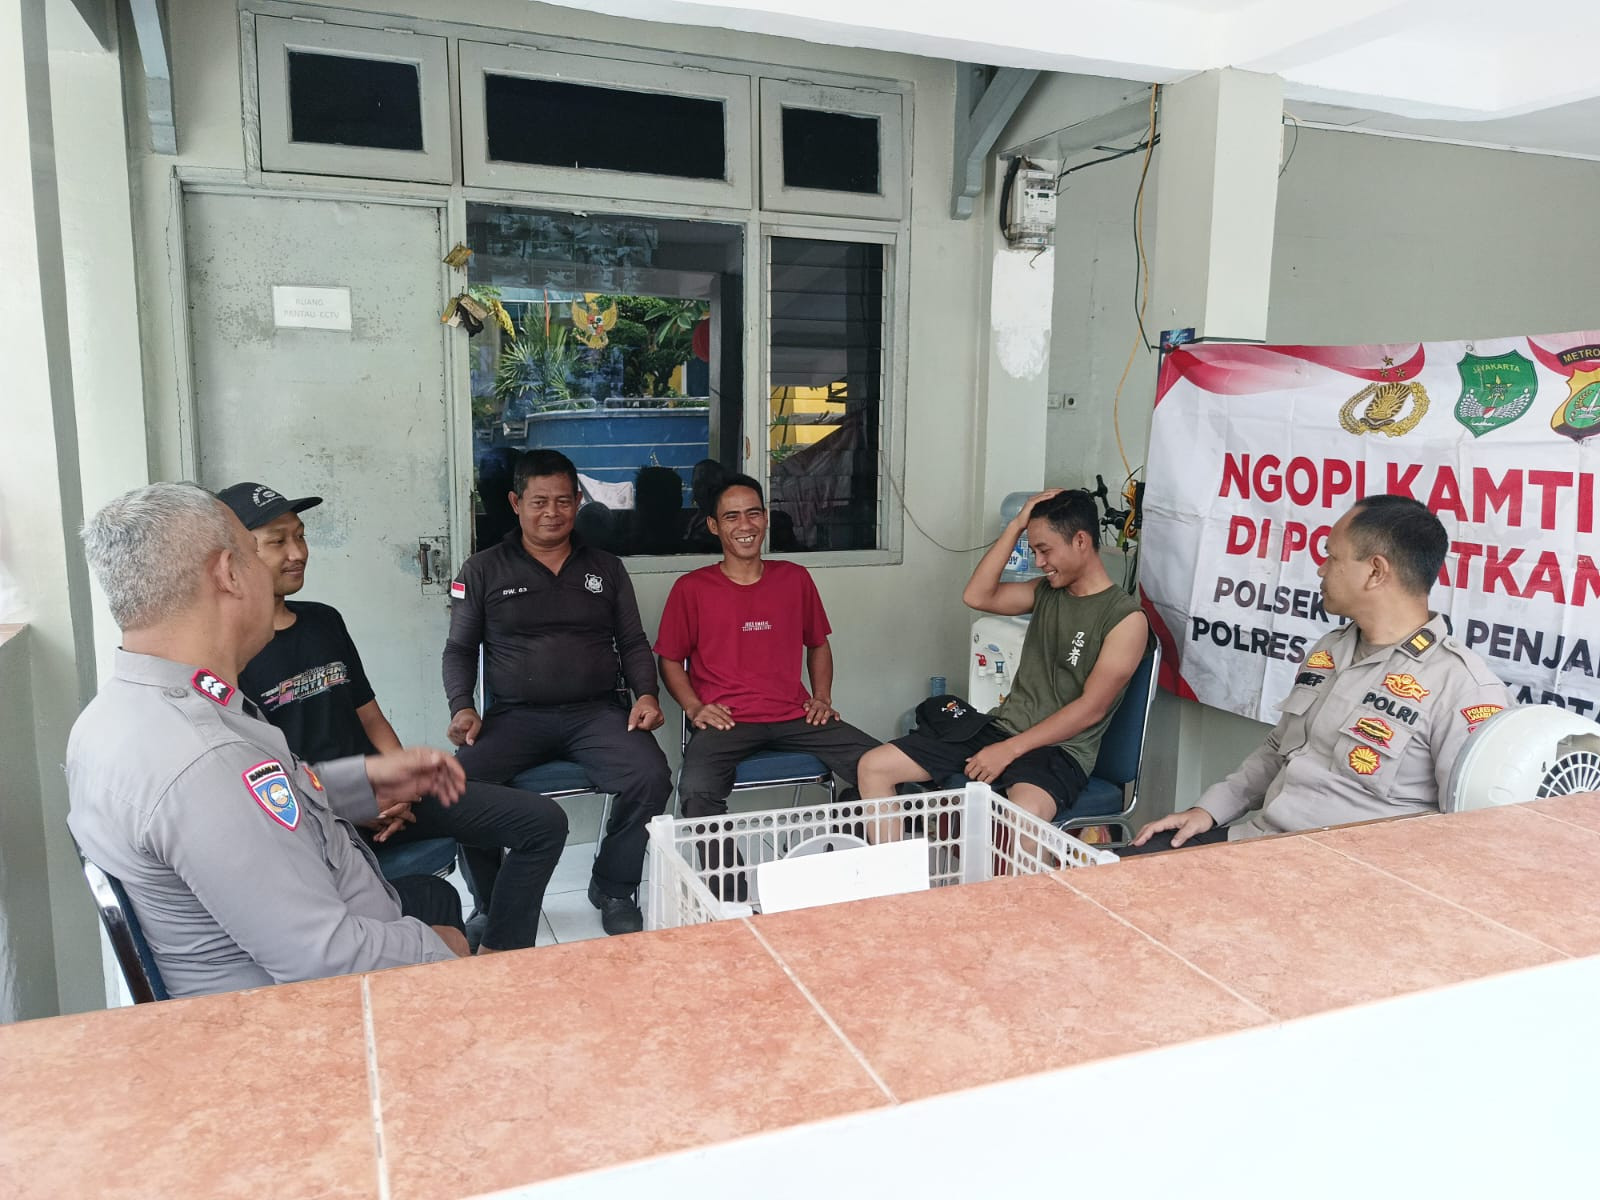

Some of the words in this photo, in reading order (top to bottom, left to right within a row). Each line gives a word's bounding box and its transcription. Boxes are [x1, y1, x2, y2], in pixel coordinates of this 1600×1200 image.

[1218, 452, 1366, 509] NGOPI
[1386, 462, 1594, 534] KAMTI
[1225, 514, 1272, 560] DI
[1280, 521, 1334, 567] PO
[1213, 576, 1329, 623] POLSEK
[1191, 616, 1308, 664] POLRES
[1465, 618, 1600, 678] PENJA
[1362, 692, 1419, 726] POLRI
